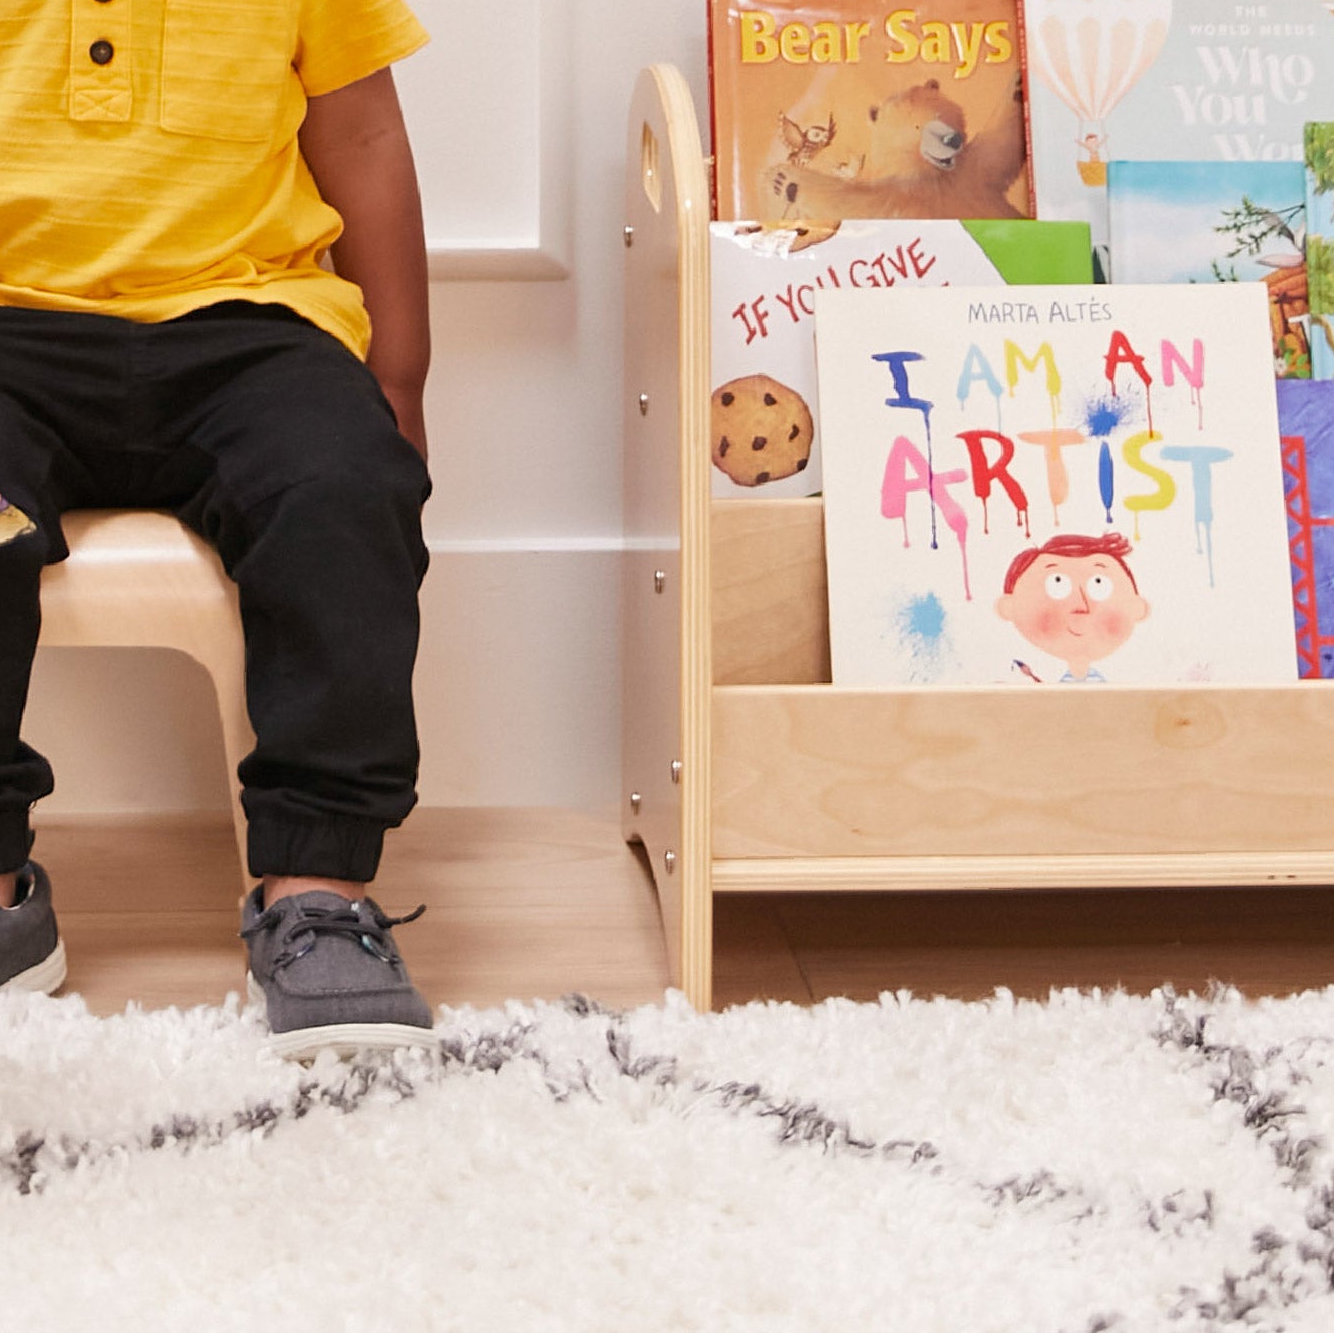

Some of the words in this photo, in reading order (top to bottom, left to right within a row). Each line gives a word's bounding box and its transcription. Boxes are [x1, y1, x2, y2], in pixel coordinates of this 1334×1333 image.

[740, 10, 870, 63] Bear
[885, 9, 1012, 79] Says
[1196, 46, 1315, 103] Who
[1171, 85, 1266, 125] You
[732, 295, 768, 344] IF
[849, 237, 936, 287] GIVE
[968, 303, 1039, 324] MARTA
[957, 338, 1061, 409] AM
[1104, 331, 1204, 397] AN
[880, 429, 1233, 545] ARTIST
